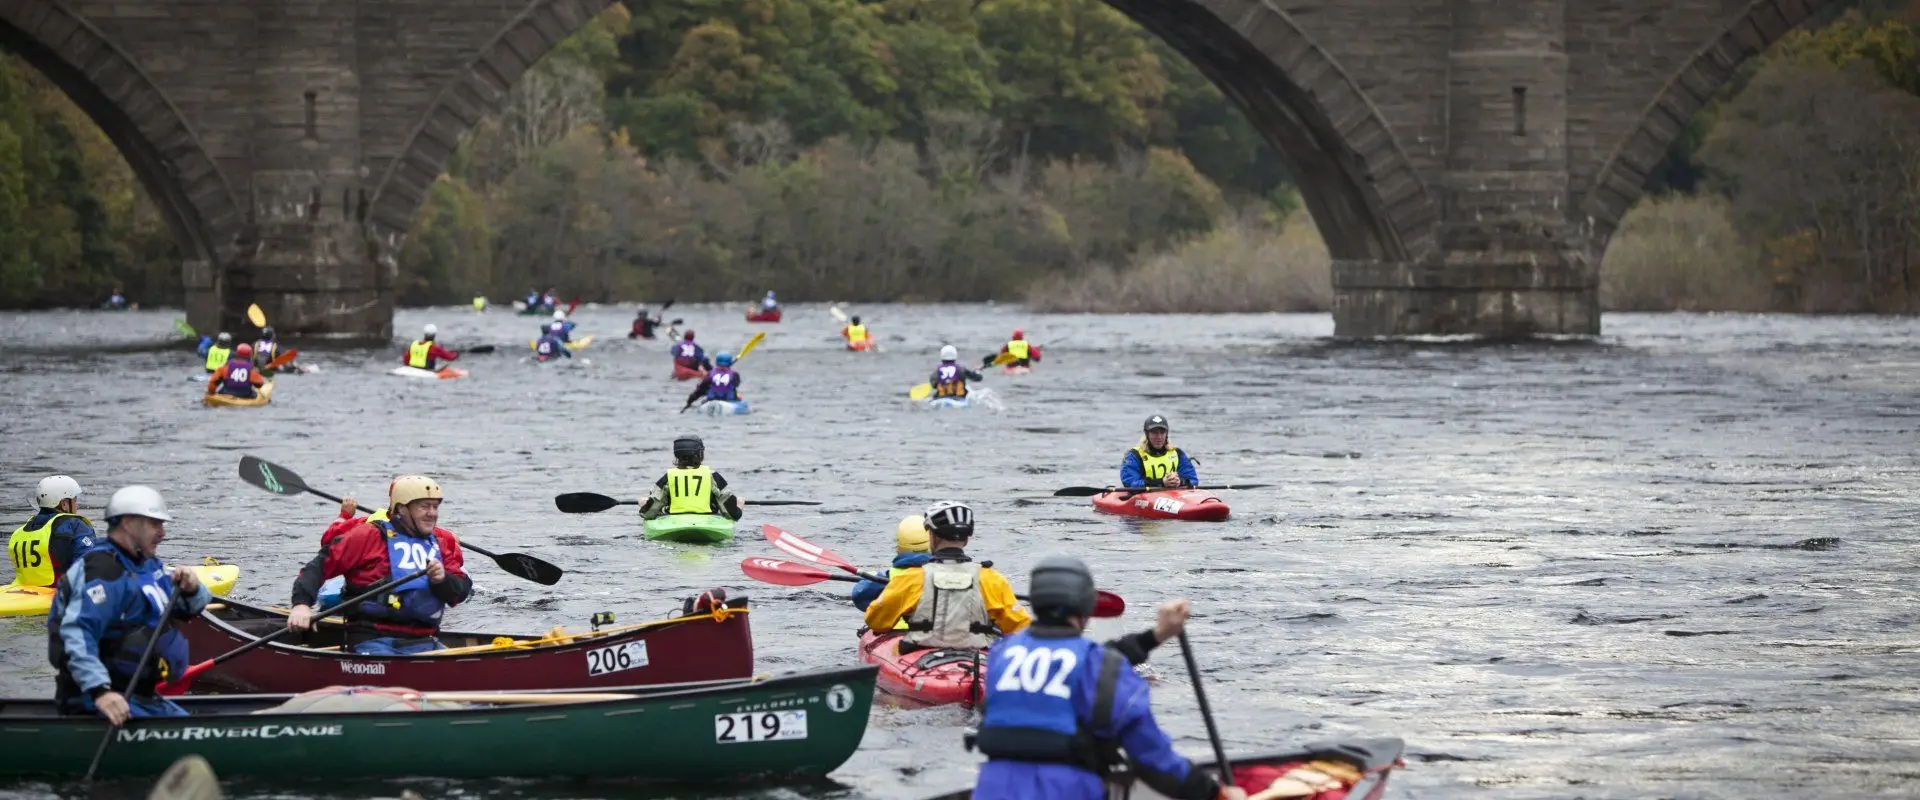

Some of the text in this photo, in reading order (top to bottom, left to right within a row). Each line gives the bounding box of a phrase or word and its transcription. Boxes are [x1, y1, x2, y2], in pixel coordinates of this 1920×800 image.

[230, 368, 248, 382] 40
[712, 373, 730, 387] 44
[674, 475, 703, 497] 117
[13, 539, 42, 569] 115
[588, 644, 631, 675] 206
[995, 644, 1078, 700] 202
[718, 713, 781, 741] 219
